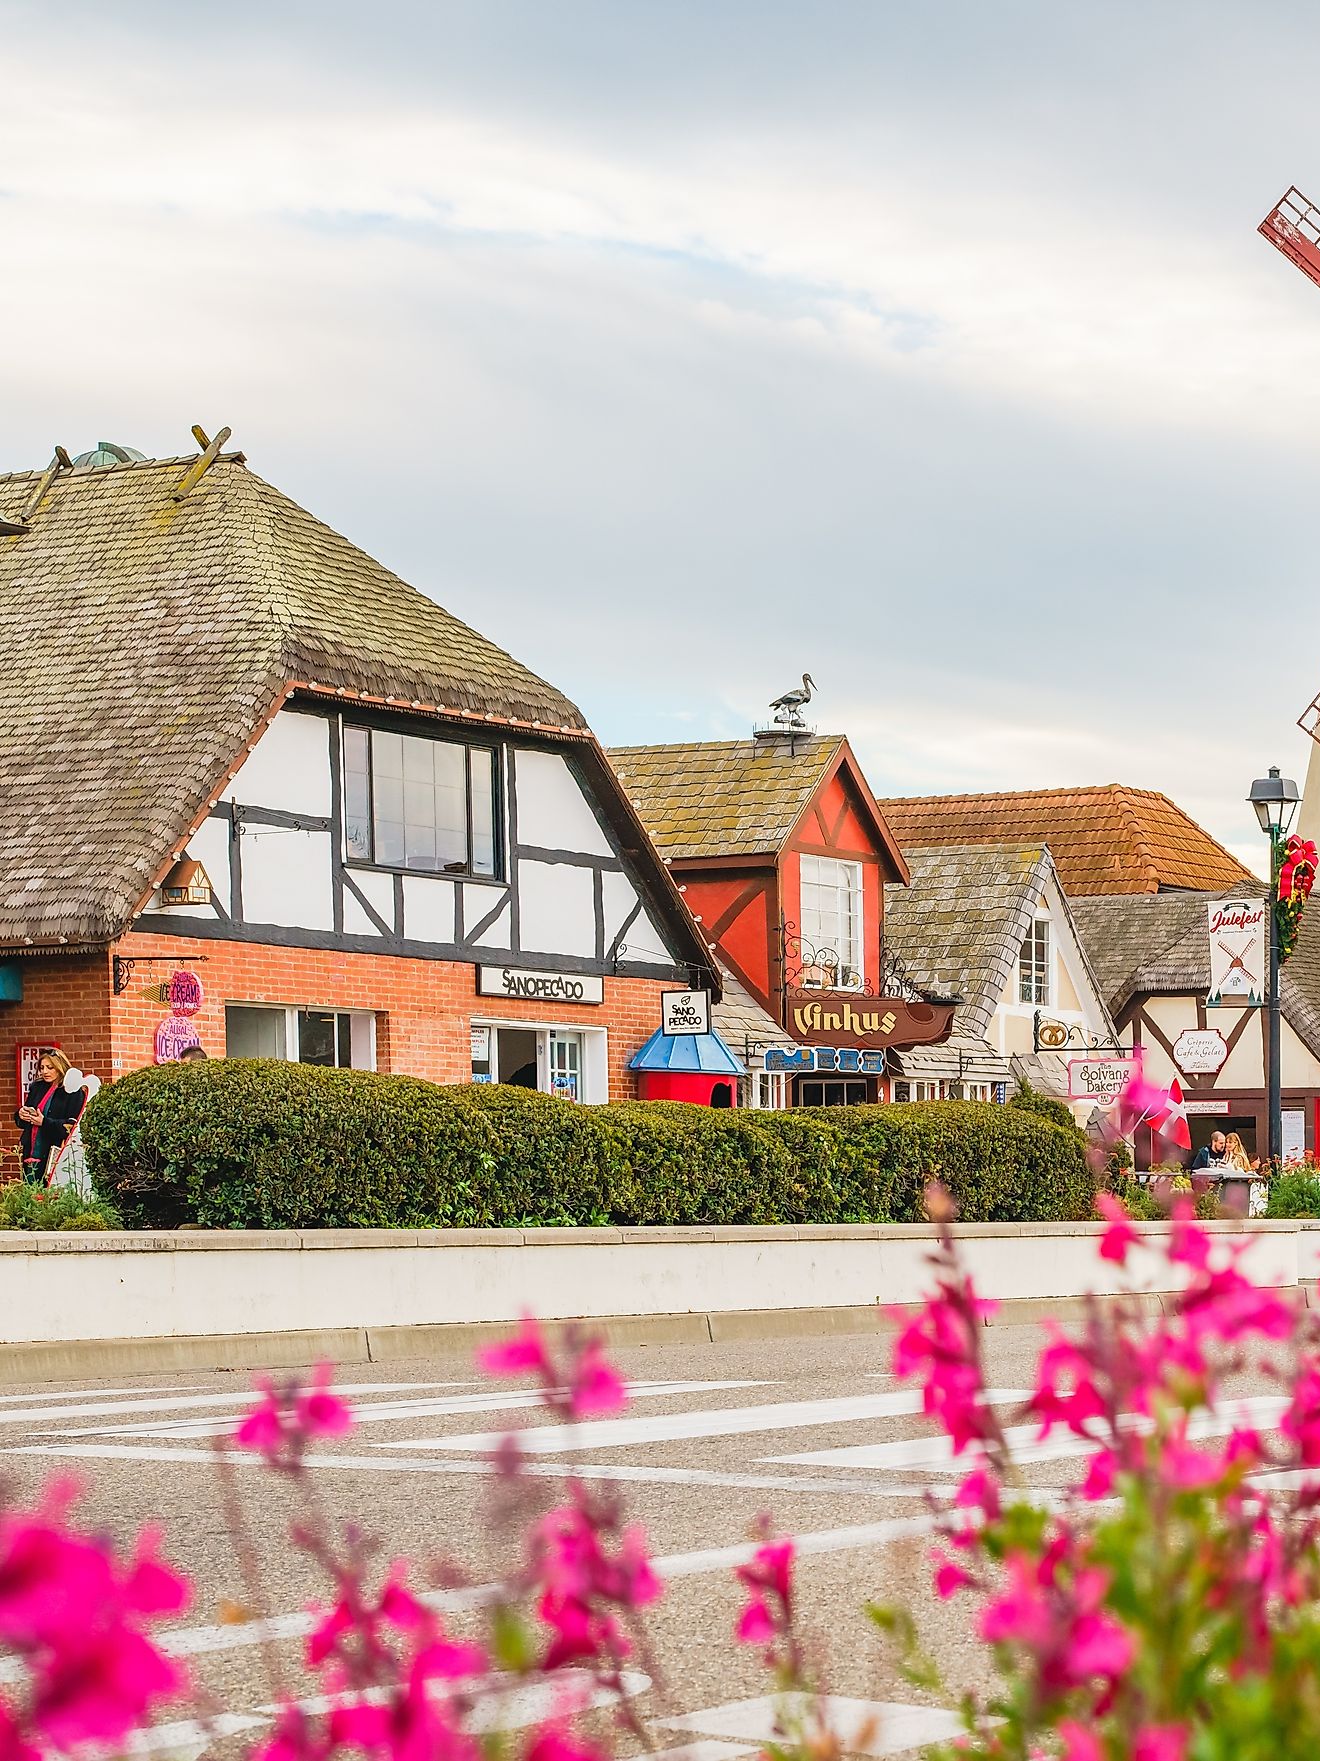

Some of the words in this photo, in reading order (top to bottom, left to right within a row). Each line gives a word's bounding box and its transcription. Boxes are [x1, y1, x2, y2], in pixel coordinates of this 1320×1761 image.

[1210, 910, 1263, 933] Julefest
[160, 983, 170, 1002] ICE
[172, 983, 197, 1004] CREAM
[502, 969, 583, 999] SANOPECADO
[669, 1015, 702, 1026] PECADO
[672, 1004, 695, 1016] SANO
[794, 1003, 897, 1036] Vinhus
[158, 1035, 170, 1057] ICE
[1080, 1065, 1129, 1084] Solvang
[1086, 1080, 1123, 1094] Bakery
